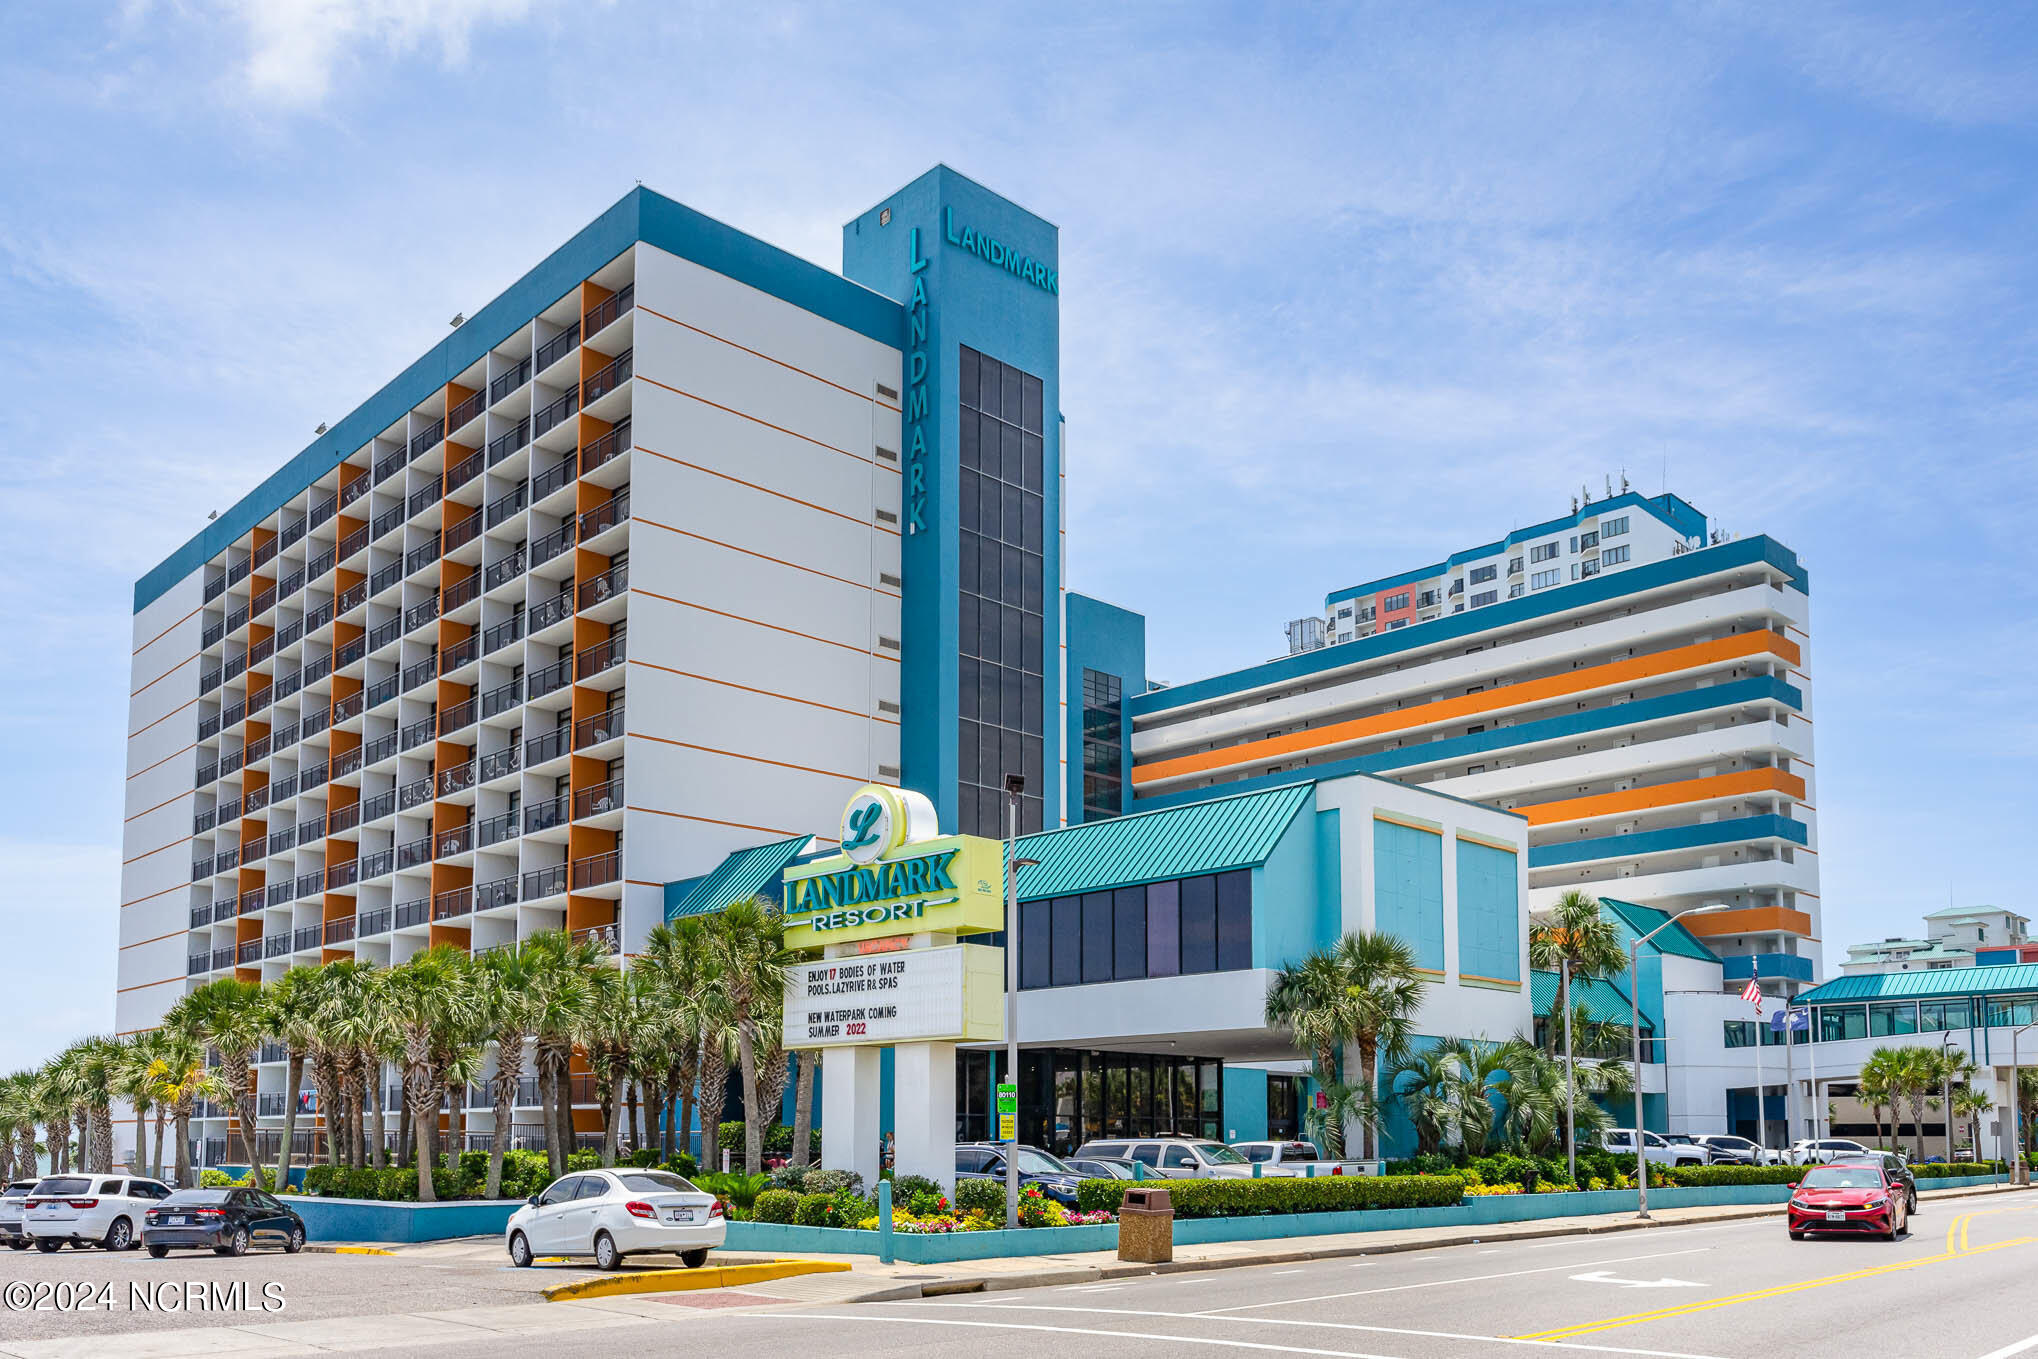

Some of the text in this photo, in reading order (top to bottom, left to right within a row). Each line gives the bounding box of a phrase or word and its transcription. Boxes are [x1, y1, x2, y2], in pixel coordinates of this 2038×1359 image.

[946, 206, 1059, 295] LANDMARK
[908, 228, 927, 534] LANDMARK
[842, 803, 882, 850] L
[784, 852, 958, 914] LANDMARK
[811, 899, 926, 931] RESORT
[808, 961, 905, 982] ENJOY 17 BODIES OF WATER
[879, 976, 898, 989] SPAS
[808, 1006, 897, 1024] NEW WATERPARK COMING
[808, 1023, 866, 1038] SUMMER 2022
